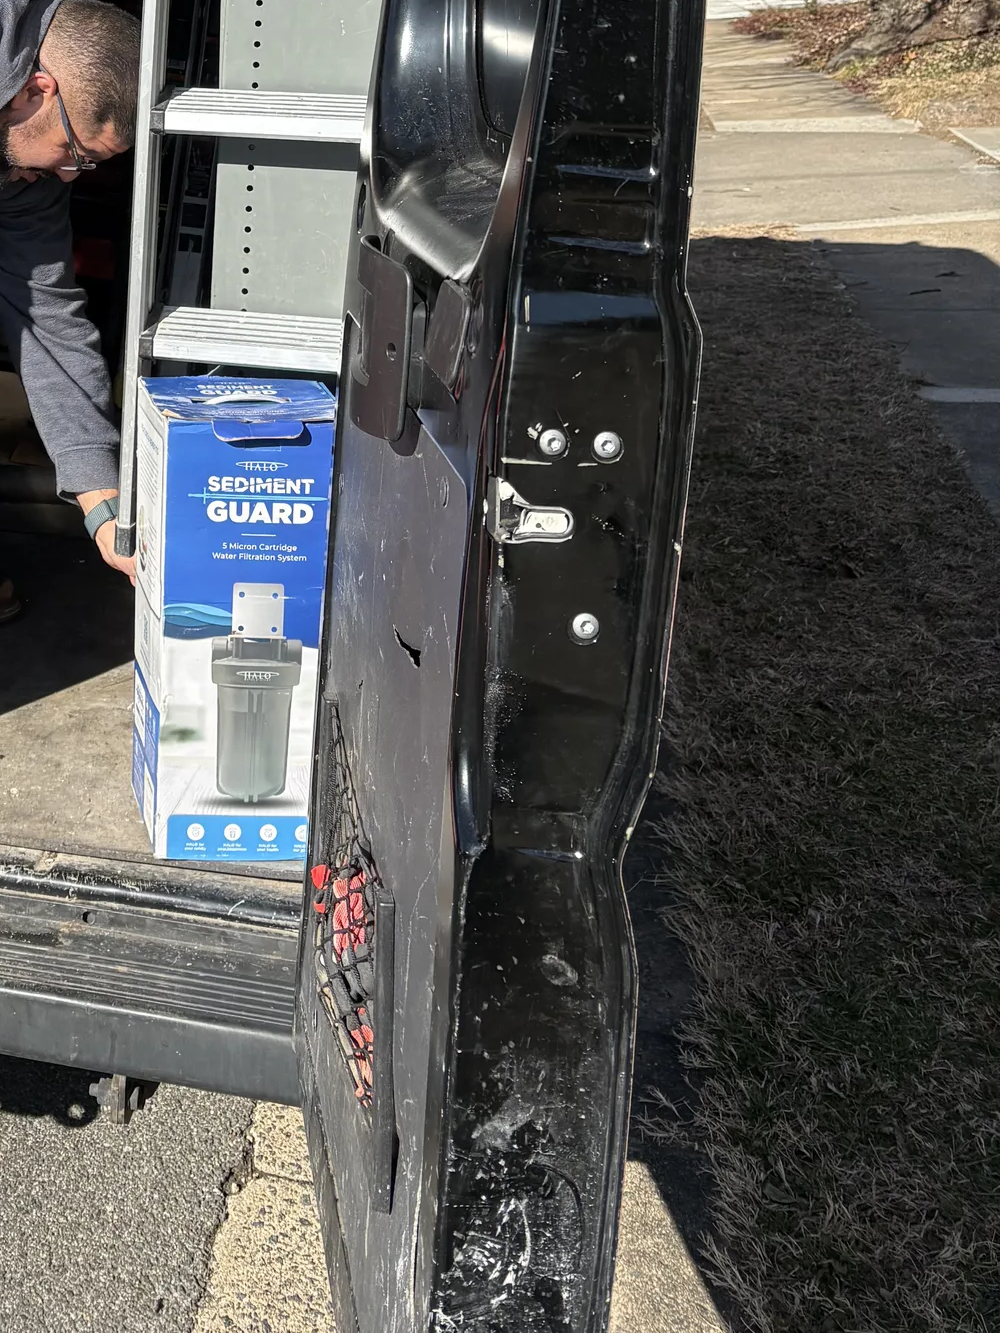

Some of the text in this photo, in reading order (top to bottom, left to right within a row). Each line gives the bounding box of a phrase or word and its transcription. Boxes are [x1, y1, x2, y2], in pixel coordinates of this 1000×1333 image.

[244, 462, 278, 472] HALO
[207, 475, 315, 495] SEDIMENT
[206, 500, 314, 525] GUARD
[222, 542, 298, 553] 5 Micron Cartridge
[212, 552, 307, 562] Water Filtration System
[244, 671, 272, 680] HALO
